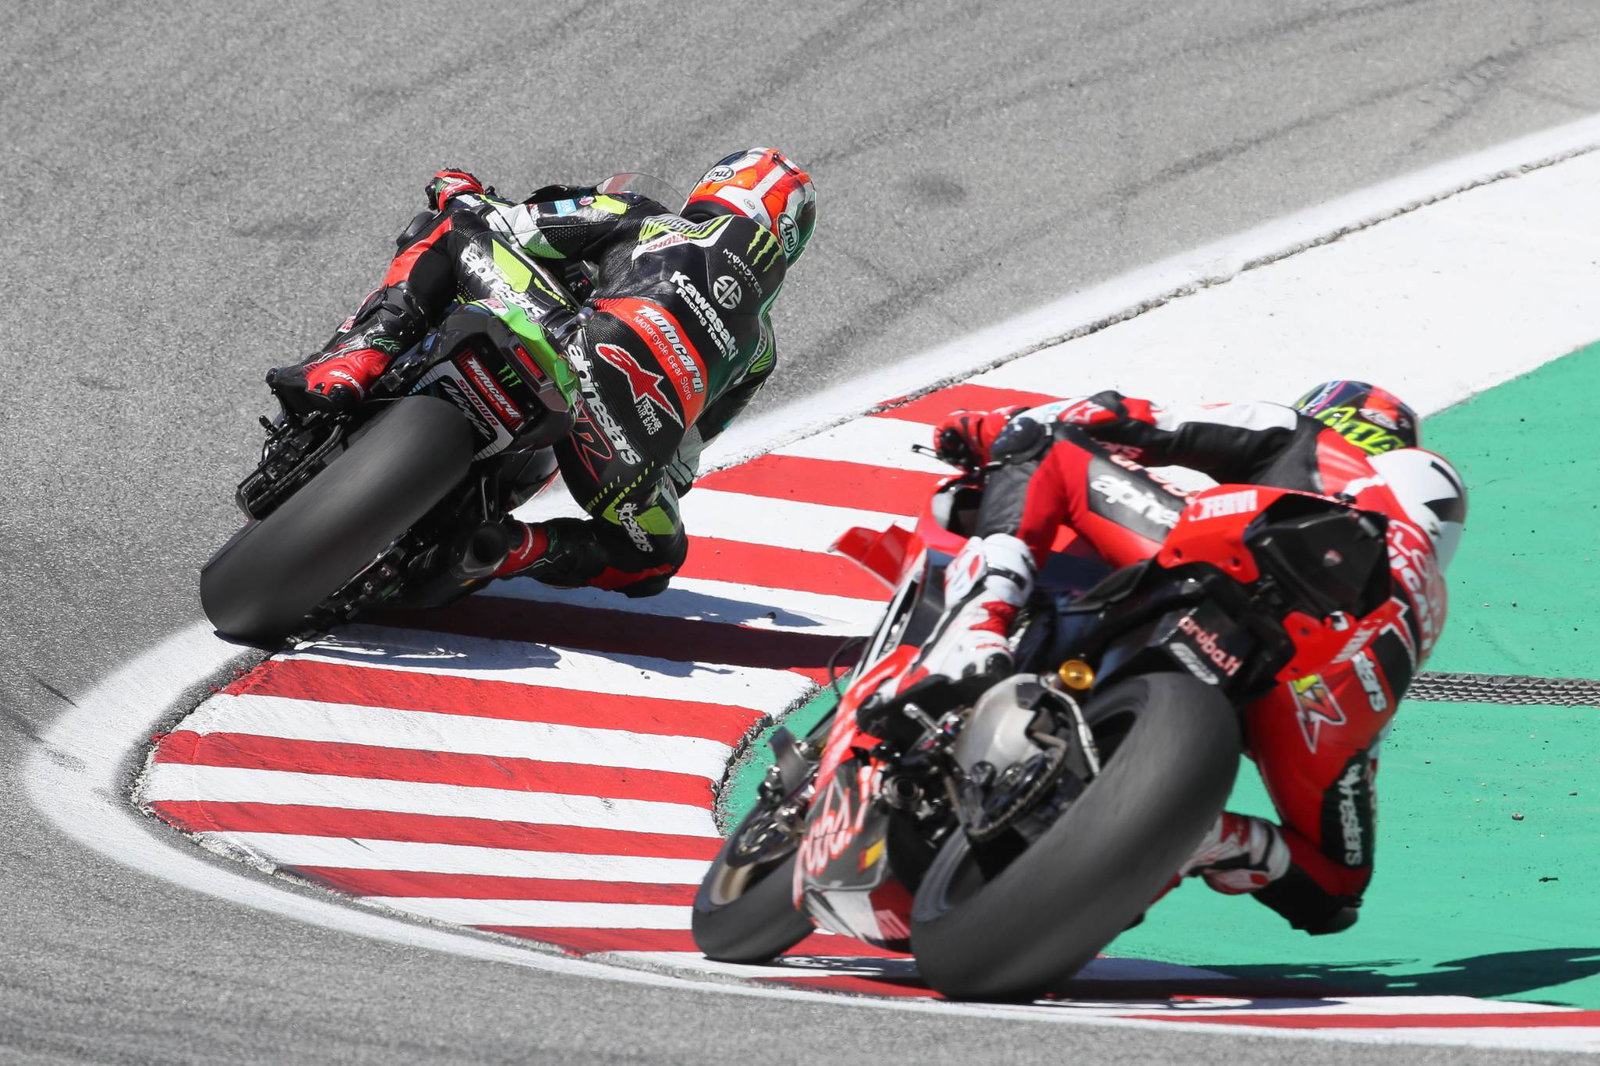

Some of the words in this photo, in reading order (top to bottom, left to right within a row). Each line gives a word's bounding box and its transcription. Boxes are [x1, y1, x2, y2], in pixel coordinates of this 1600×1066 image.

[782, 215, 796, 251] Arai
[670, 270, 739, 362] Kawasaki
[676, 288, 707, 327] Racing
[704, 321, 727, 359] Team
[633, 315, 668, 357] Motorcycle
[666, 354, 683, 377] Gear
[680, 375, 693, 401] Store
[456, 378, 499, 427] SHOWA
[567, 344, 643, 467] alpinestars
[635, 399, 648, 419] AIR
[642, 416, 657, 436] BAG
